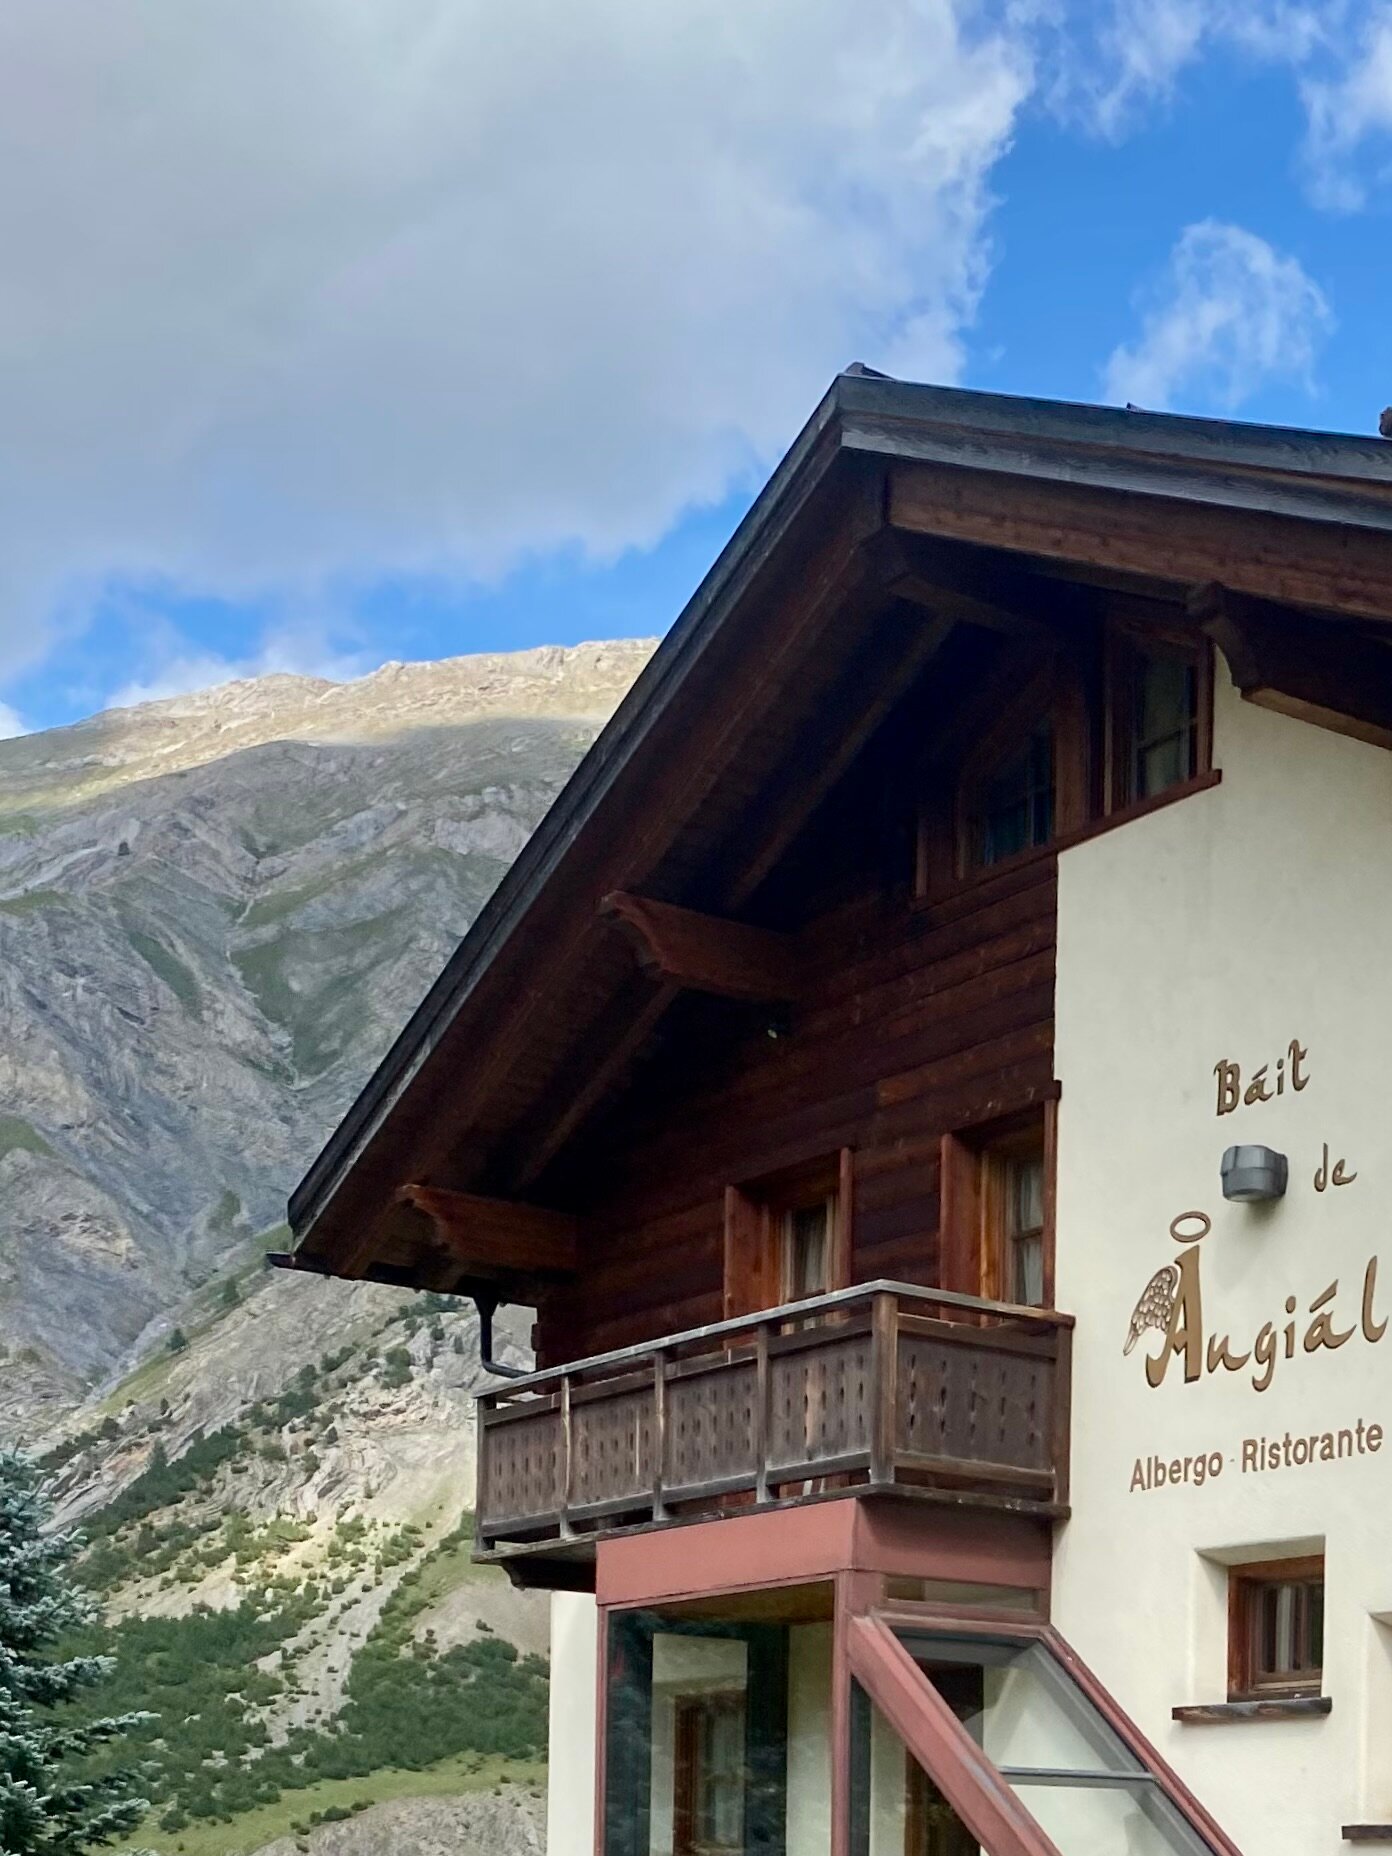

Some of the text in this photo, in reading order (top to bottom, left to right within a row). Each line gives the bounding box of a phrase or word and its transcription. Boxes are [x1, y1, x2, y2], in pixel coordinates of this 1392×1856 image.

[1214, 1039, 1310, 1116] Báit
[1314, 1142, 1358, 1192] de
[1145, 1245, 1389, 1393] Angiál
[1130, 1451, 1223, 1493] Albergo
[1242, 1418, 1385, 1473] Ristorante
